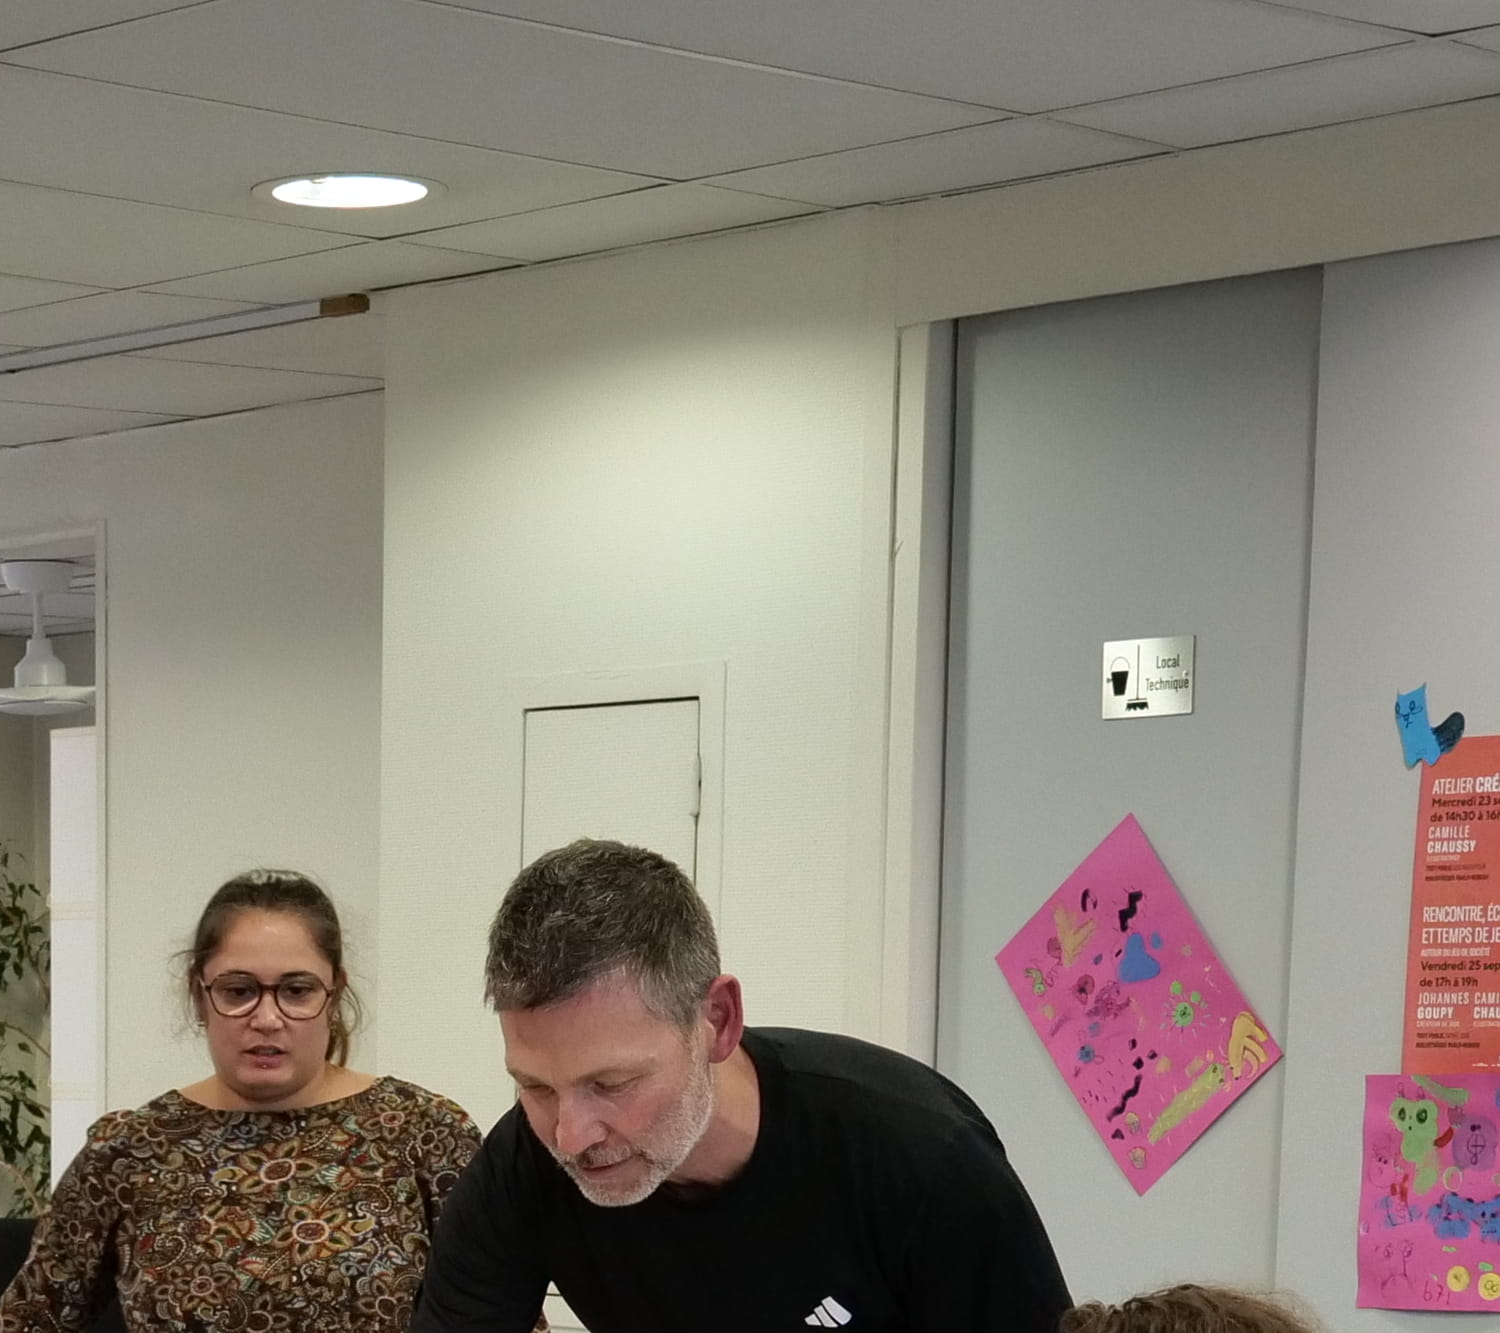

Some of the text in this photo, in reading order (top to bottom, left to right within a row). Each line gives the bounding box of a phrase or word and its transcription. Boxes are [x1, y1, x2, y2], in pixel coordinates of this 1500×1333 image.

[1156, 653, 1180, 669] Local
[1145, 677, 1190, 693] Technique
[1432, 779, 1474, 795] ATELIER
[1432, 797, 1476, 808] Mercredi
[1478, 796, 1492, 805] 23
[1430, 811, 1443, 823] de
[1445, 809, 1476, 821] 14h30
[1477, 809, 1483, 820] à
[1428, 825, 1470, 839] CAMILLE
[1427, 840, 1477, 854] CHAUSSY
[1423, 905, 1486, 923] RENCONTRE,
[1422, 929, 1435, 944] ET
[1435, 928, 1472, 943] TEMPS
[1475, 928, 1489, 943] DE
[1420, 960, 1467, 971] Vendredi
[1469, 960, 1481, 970] 25
[1420, 976, 1478, 987] de 17h à 19h
[1418, 992, 1469, 1005] JOHANNES
[1417, 1006, 1454, 1020] GOUPY
